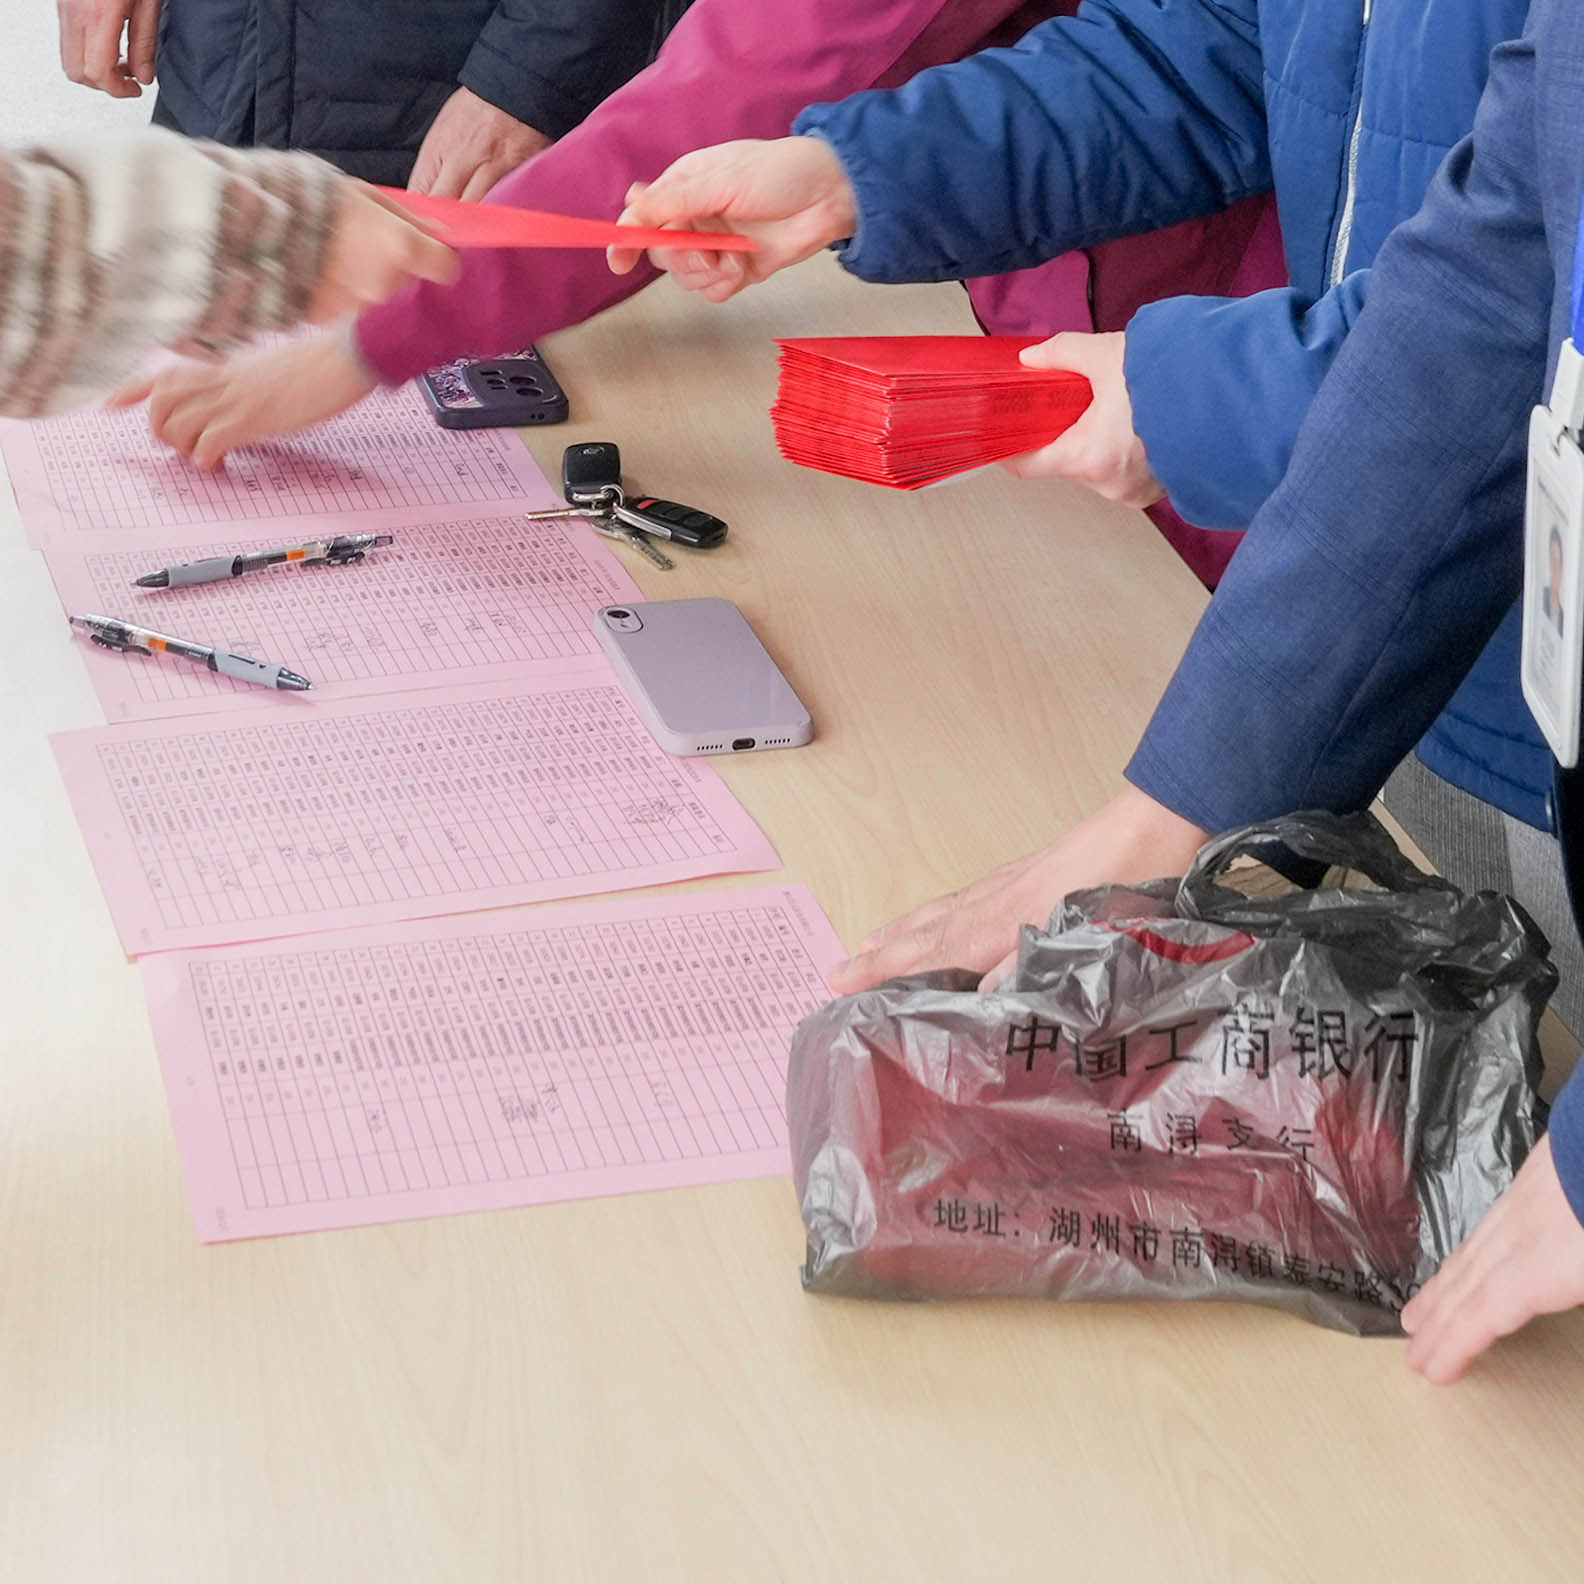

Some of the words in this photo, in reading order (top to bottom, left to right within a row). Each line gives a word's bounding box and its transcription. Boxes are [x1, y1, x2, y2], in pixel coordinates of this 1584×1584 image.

[1006, 1007, 1419, 1083] 中国工商银行
[1108, 1108, 1315, 1162] 南浔支行
